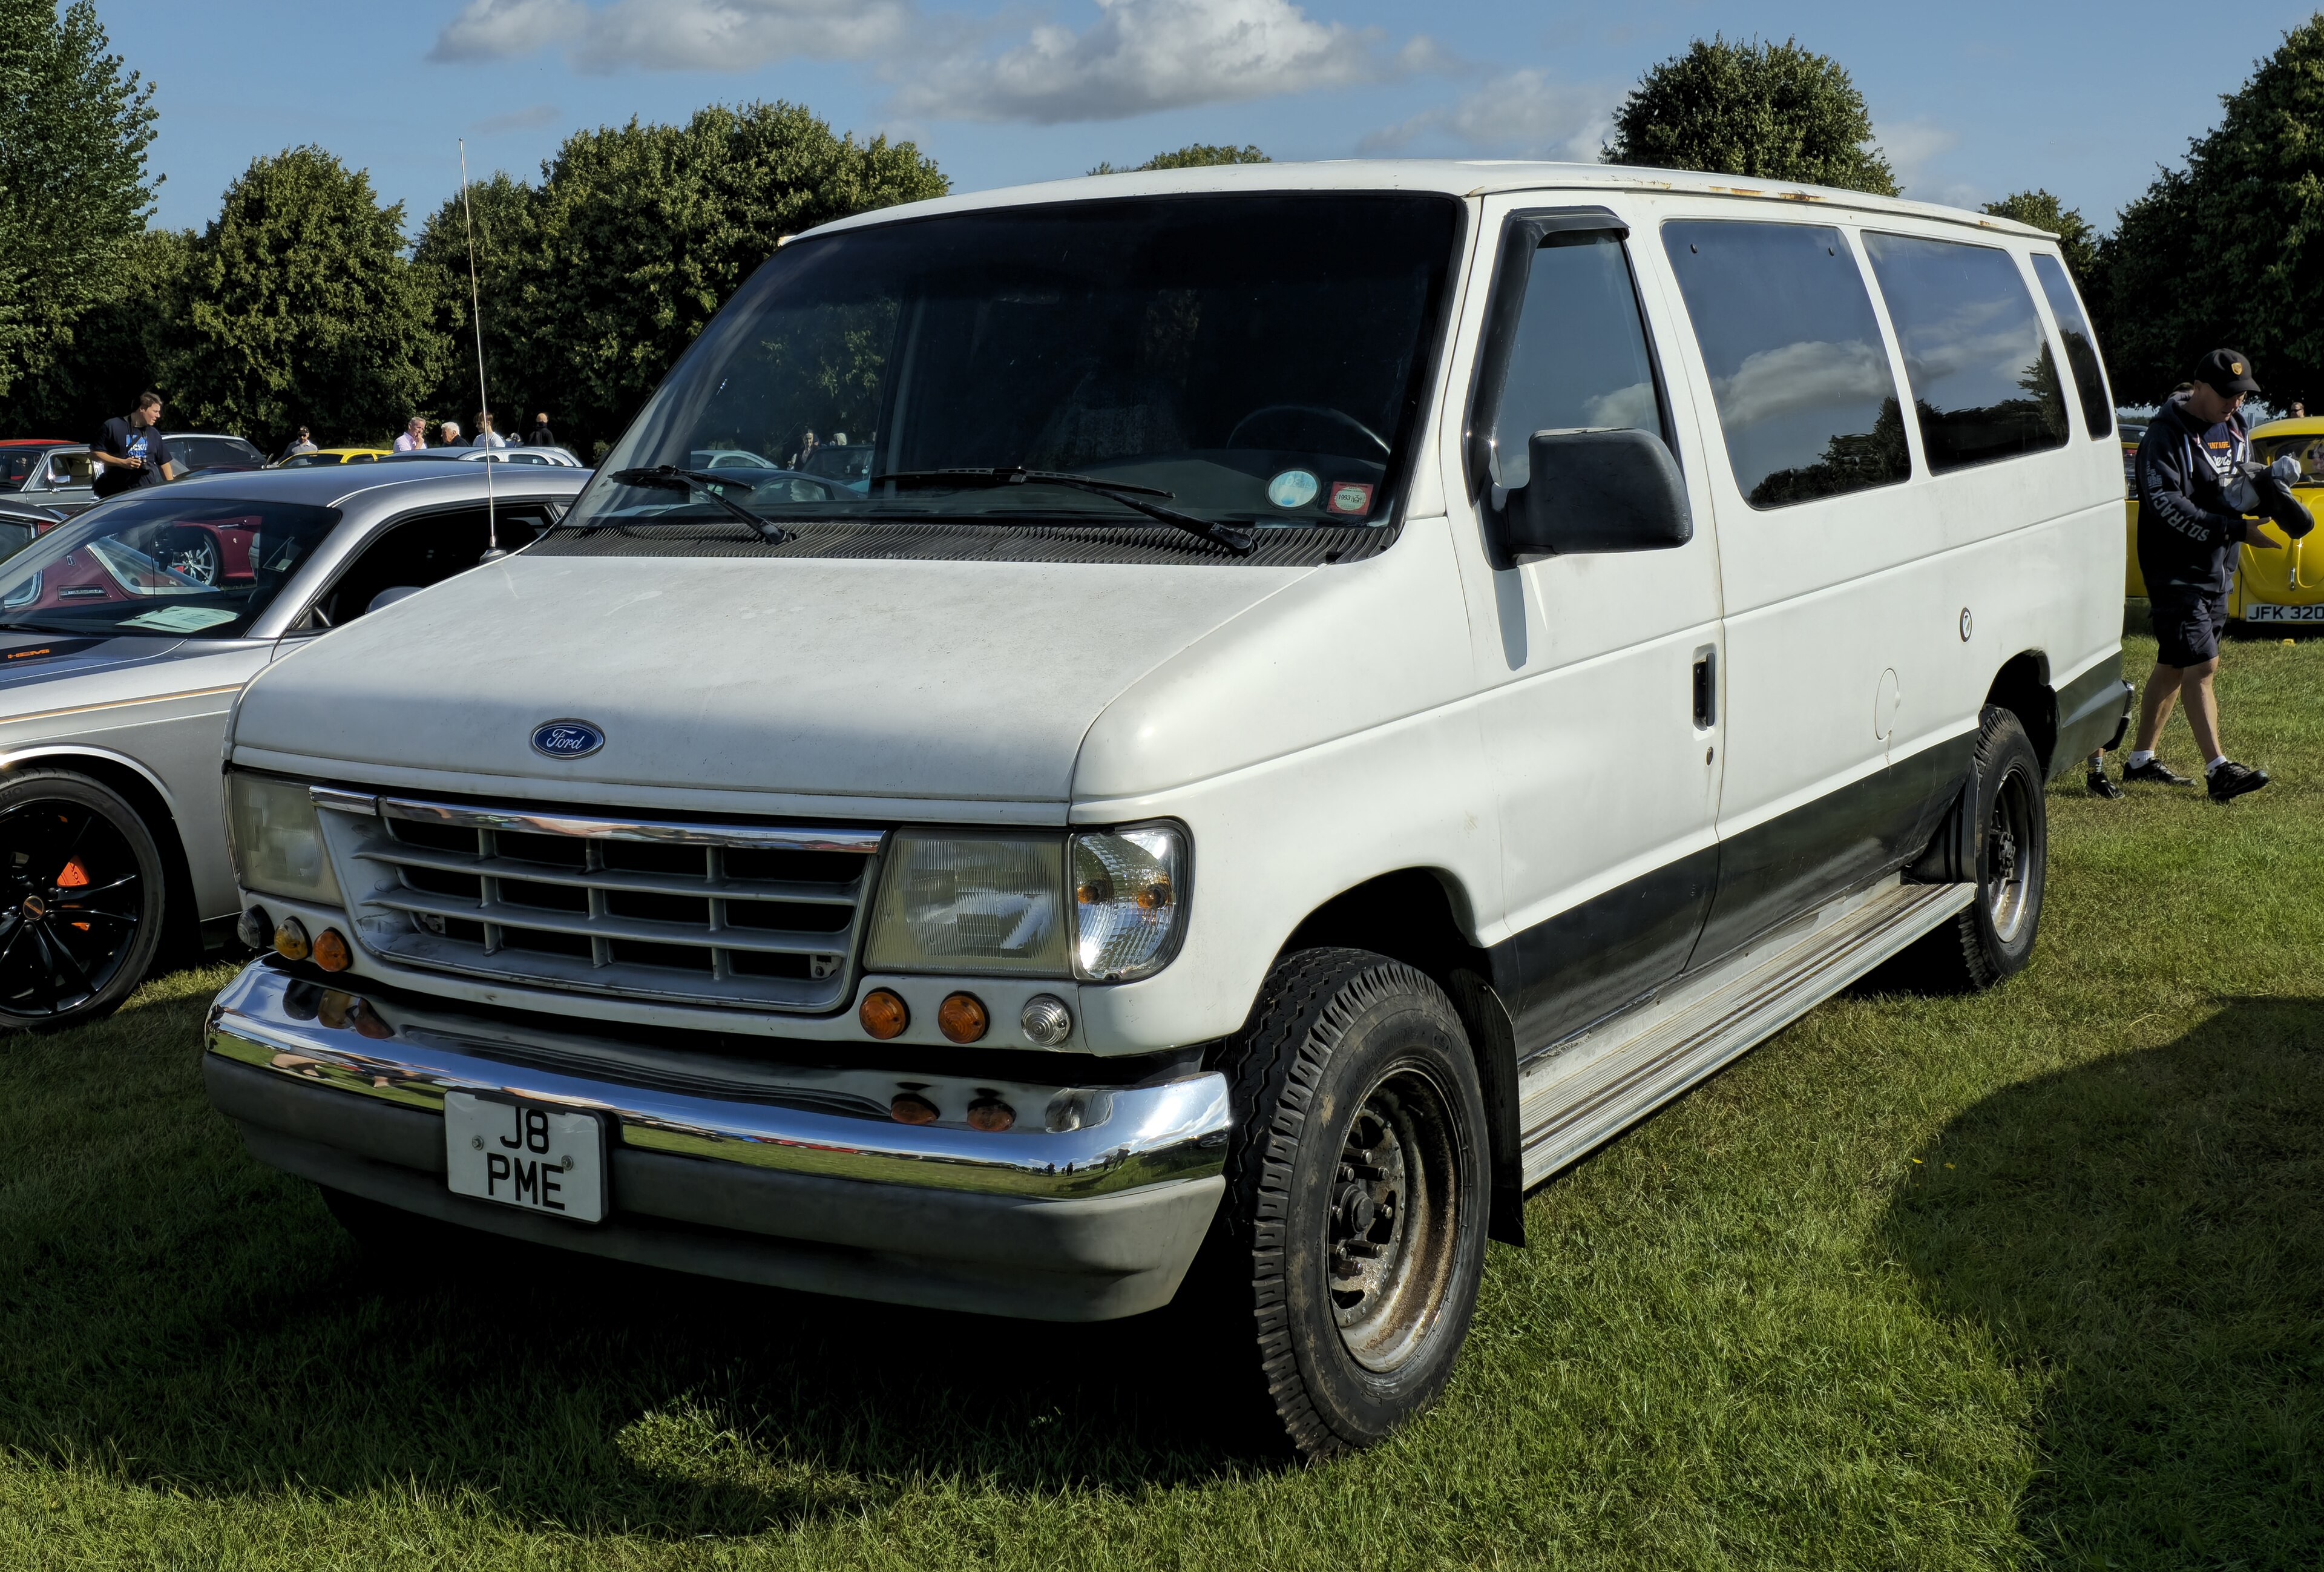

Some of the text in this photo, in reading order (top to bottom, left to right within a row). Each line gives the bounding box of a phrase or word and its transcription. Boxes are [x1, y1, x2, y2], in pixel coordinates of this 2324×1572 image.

[2248, 606, 2324, 620] JFK 320
[7, 648, 51, 659] HEMI
[547, 728, 585, 749] Ford
[499, 1107, 550, 1155] J8
[487, 1153, 566, 1211] PME
